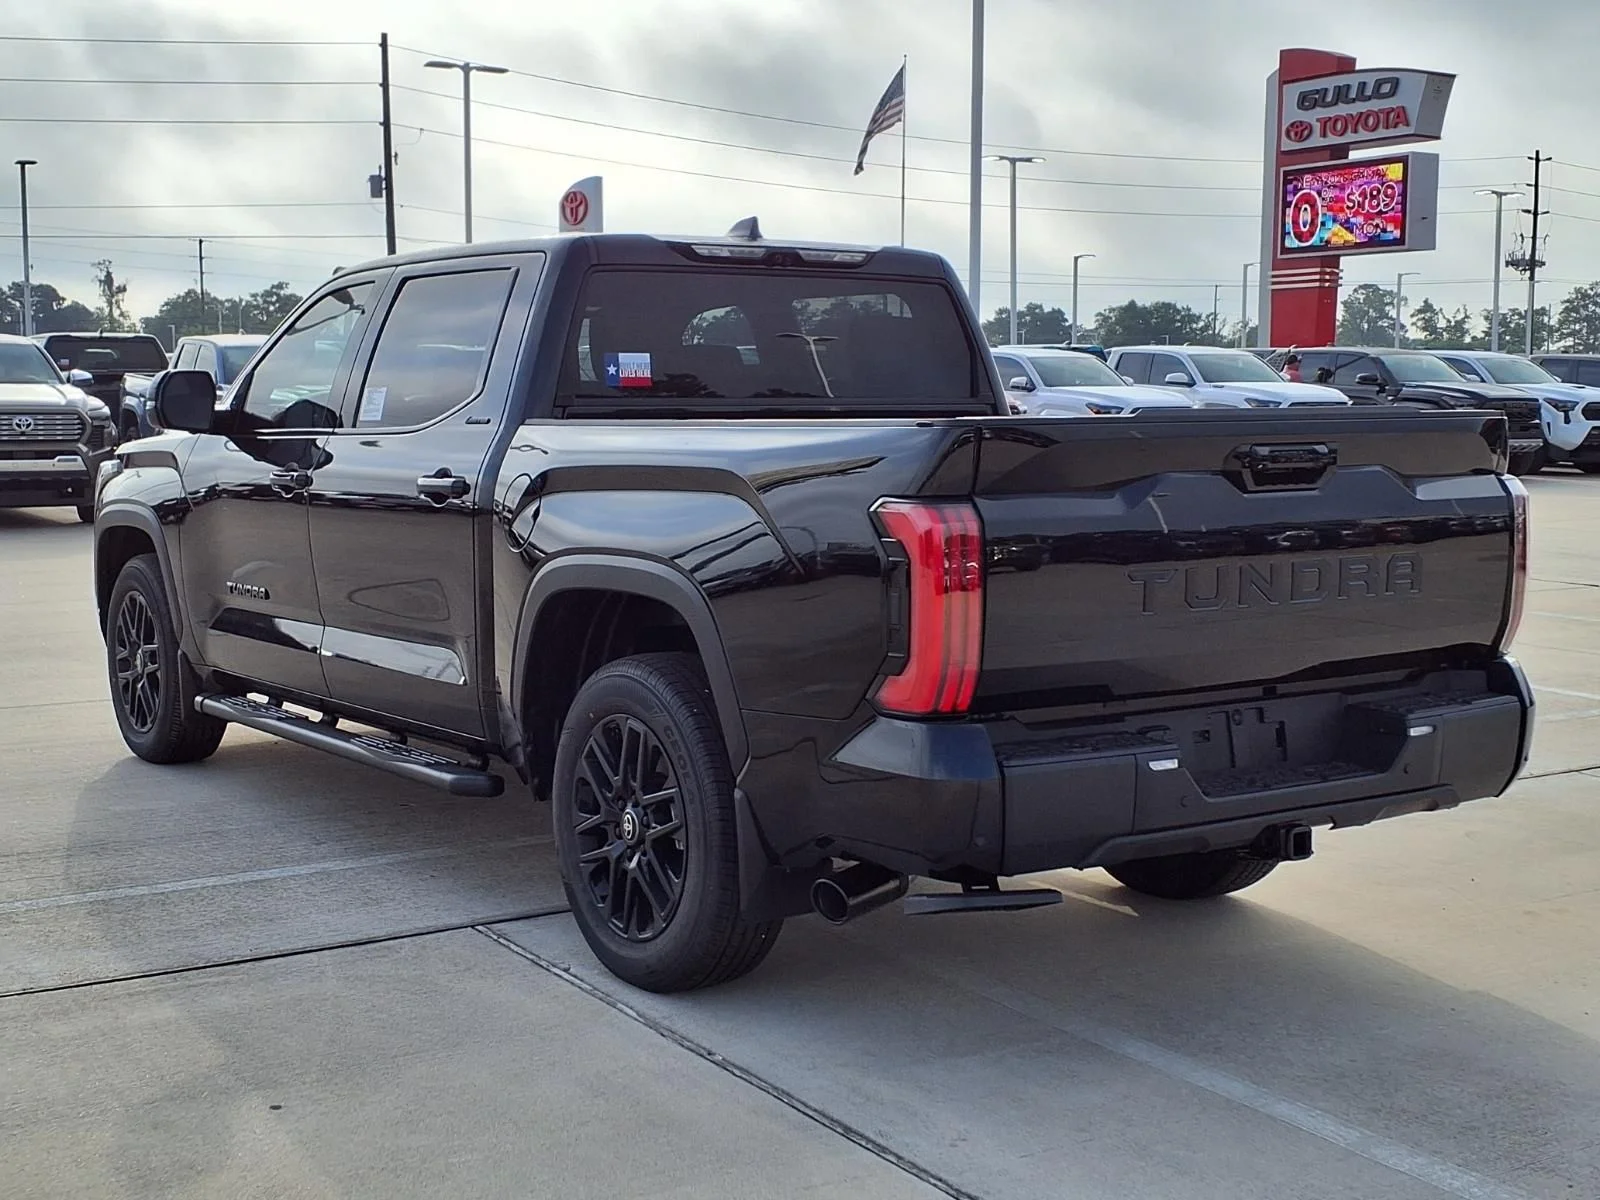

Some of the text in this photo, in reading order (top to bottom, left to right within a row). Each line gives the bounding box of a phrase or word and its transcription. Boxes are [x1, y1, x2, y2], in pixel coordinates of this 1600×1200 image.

[1297, 77, 1400, 111] GULLO
[1316, 106, 1409, 138] TOYOTA
[1345, 182, 1398, 217] $189
[636, 367, 652, 378] HERE
[226, 581, 268, 600] TUNDRA
[1126, 551, 1424, 615] TUNDRA
